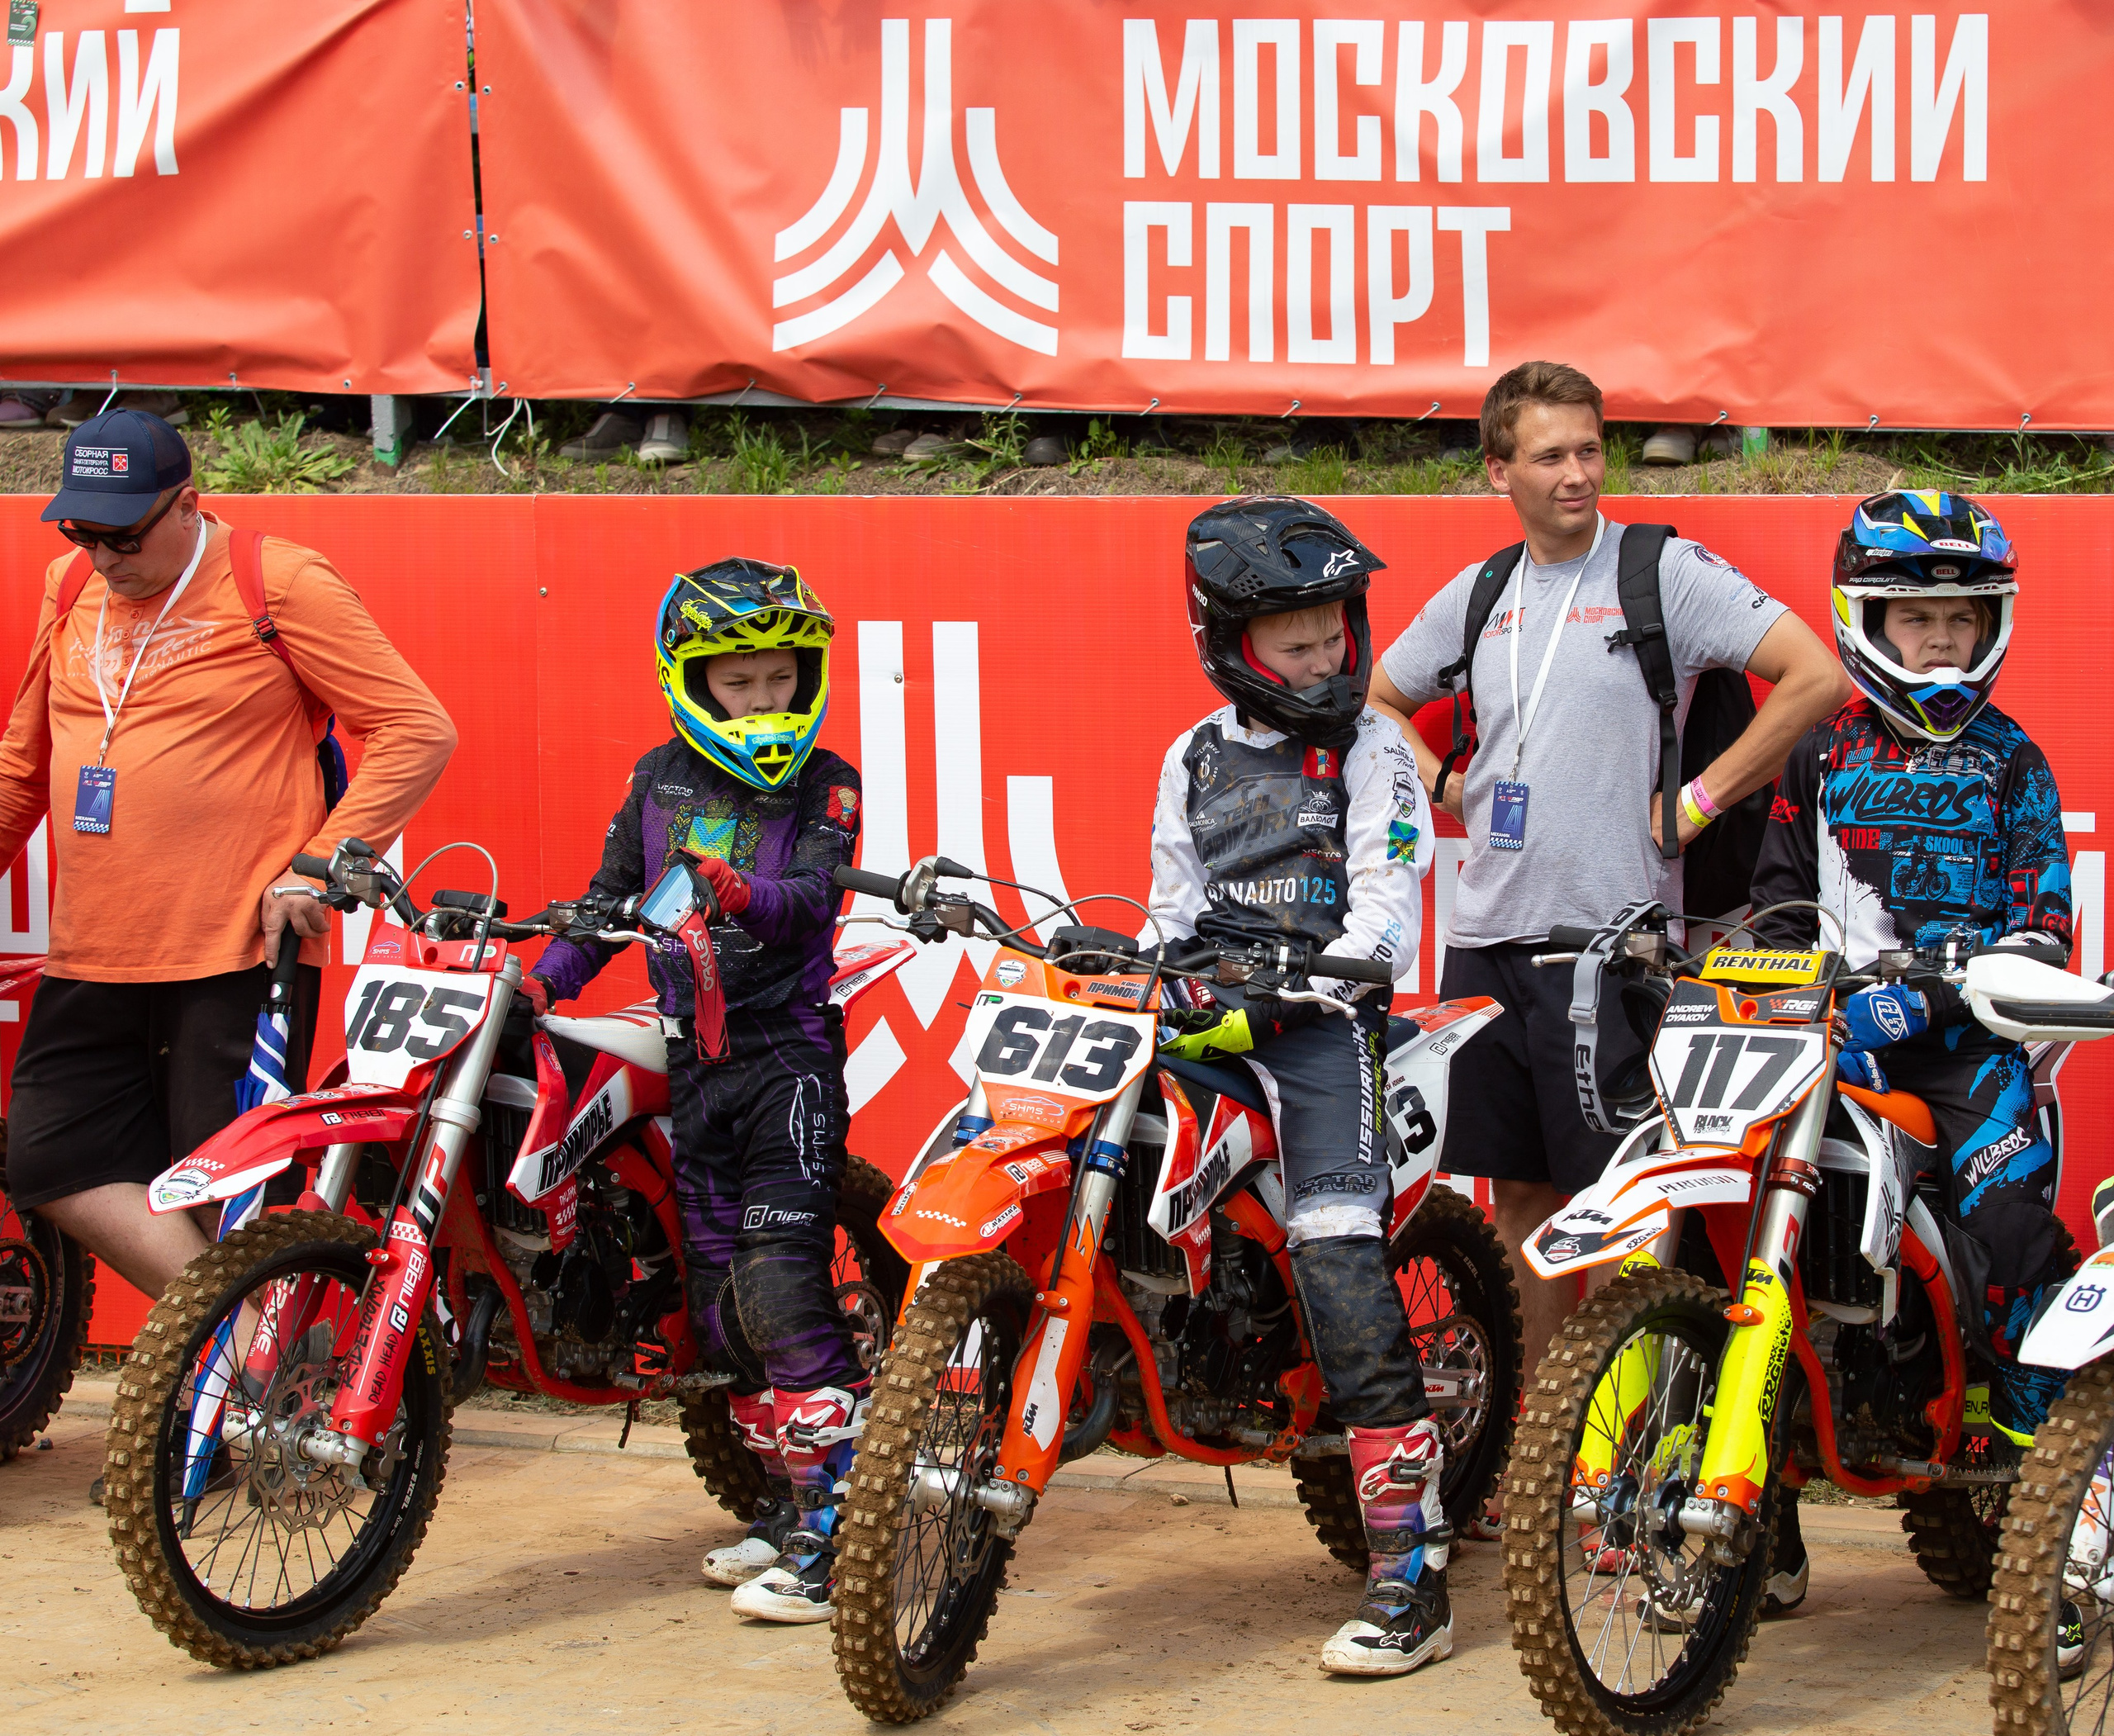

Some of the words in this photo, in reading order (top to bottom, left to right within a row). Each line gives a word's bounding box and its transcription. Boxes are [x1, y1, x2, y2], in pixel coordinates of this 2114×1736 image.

[1123, 14, 1989, 183] МОСКОВСКИЙ
[1121, 202, 1511, 367] СПОРТ
[74, 448, 109, 458] СБОРНАЯ
[72, 465, 109, 476] МОТОКРОСС
[1939, 542, 1972, 550] BELL
[1936, 568, 1956, 576] BELL
[1583, 615, 1605, 624] СПОРТ
[1585, 607, 1625, 616] МОСКОВСКИ
[1827, 776, 1984, 826] WILLBROS
[1300, 815, 1335, 824] ВАЛЕОЛОГ
[1841, 828, 1881, 850] RIDE
[1926, 836, 1965, 855] SKOOL
[1300, 875, 1336, 905] 125
[1380, 918, 1402, 949] 125
[661, 938, 722, 955] SHS
[686, 928, 715, 992] OAKLEY
[1711, 956, 1814, 972] RENTHAL
[1087, 981, 1145, 1002] ПРИМОР
[346, 979, 486, 1060] 185
[1665, 1013, 1709, 1023] DYAKOV
[1666, 1004, 1717, 1013] ANDREW
[975, 1005, 1143, 1093] 613
[1671, 1033, 1808, 1112] 117
[1009, 1103, 1045, 1116] SHMS
[535, 1089, 614, 1197] ПРИМОРЬЕ
[812, 1112, 826, 1174] SHMS
[1964, 1126, 2031, 1188] WILLBROS
[1561, 1209, 1614, 1226] KTM
[397, 1247, 425, 1308] NIBBI
[417, 1255, 428, 1282] RACING
[1462, 1255, 1479, 1278] EXCEL
[1623, 1260, 1650, 1277] KT
[1747, 1267, 1775, 1286] TM
[377, 1333, 400, 1368] HEAD
[367, 1369, 388, 1405] DEAD
[1022, 1402, 1040, 1438] KTM
[401, 1472, 418, 1510] EXCEL
